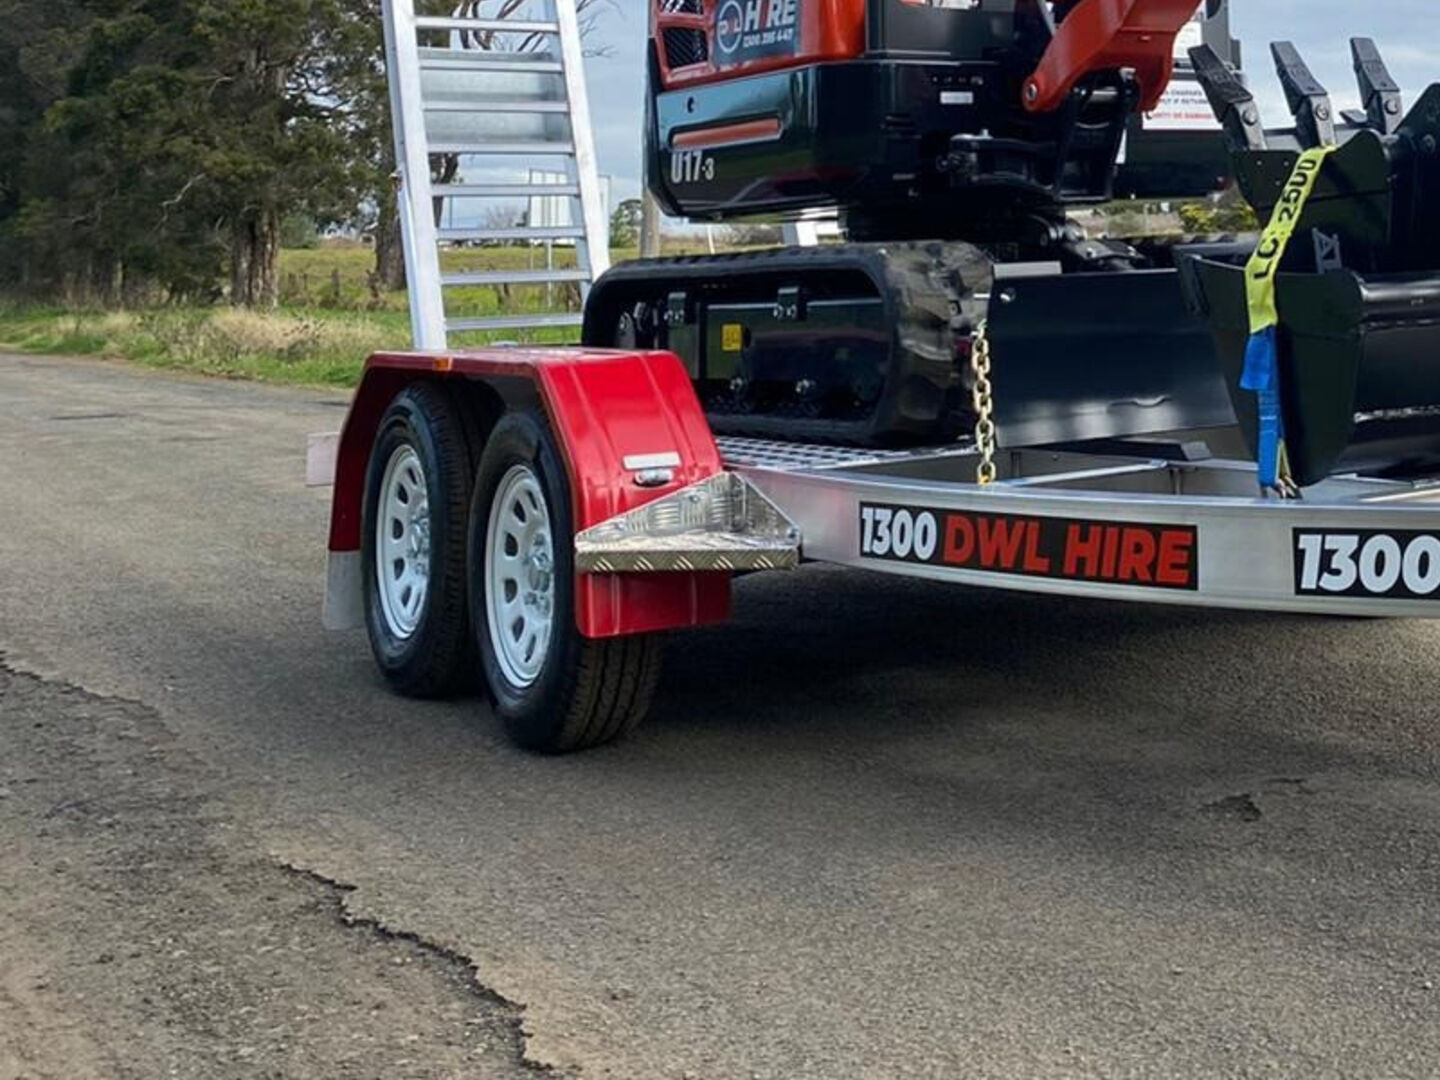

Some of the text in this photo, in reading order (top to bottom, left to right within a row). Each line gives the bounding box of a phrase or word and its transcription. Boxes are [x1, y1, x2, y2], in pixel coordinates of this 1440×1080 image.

[671, 149, 715, 185] U17-3
[1278, 158, 1316, 223] 2500
[861, 507, 1194, 585] 1300 DWL HIRE
